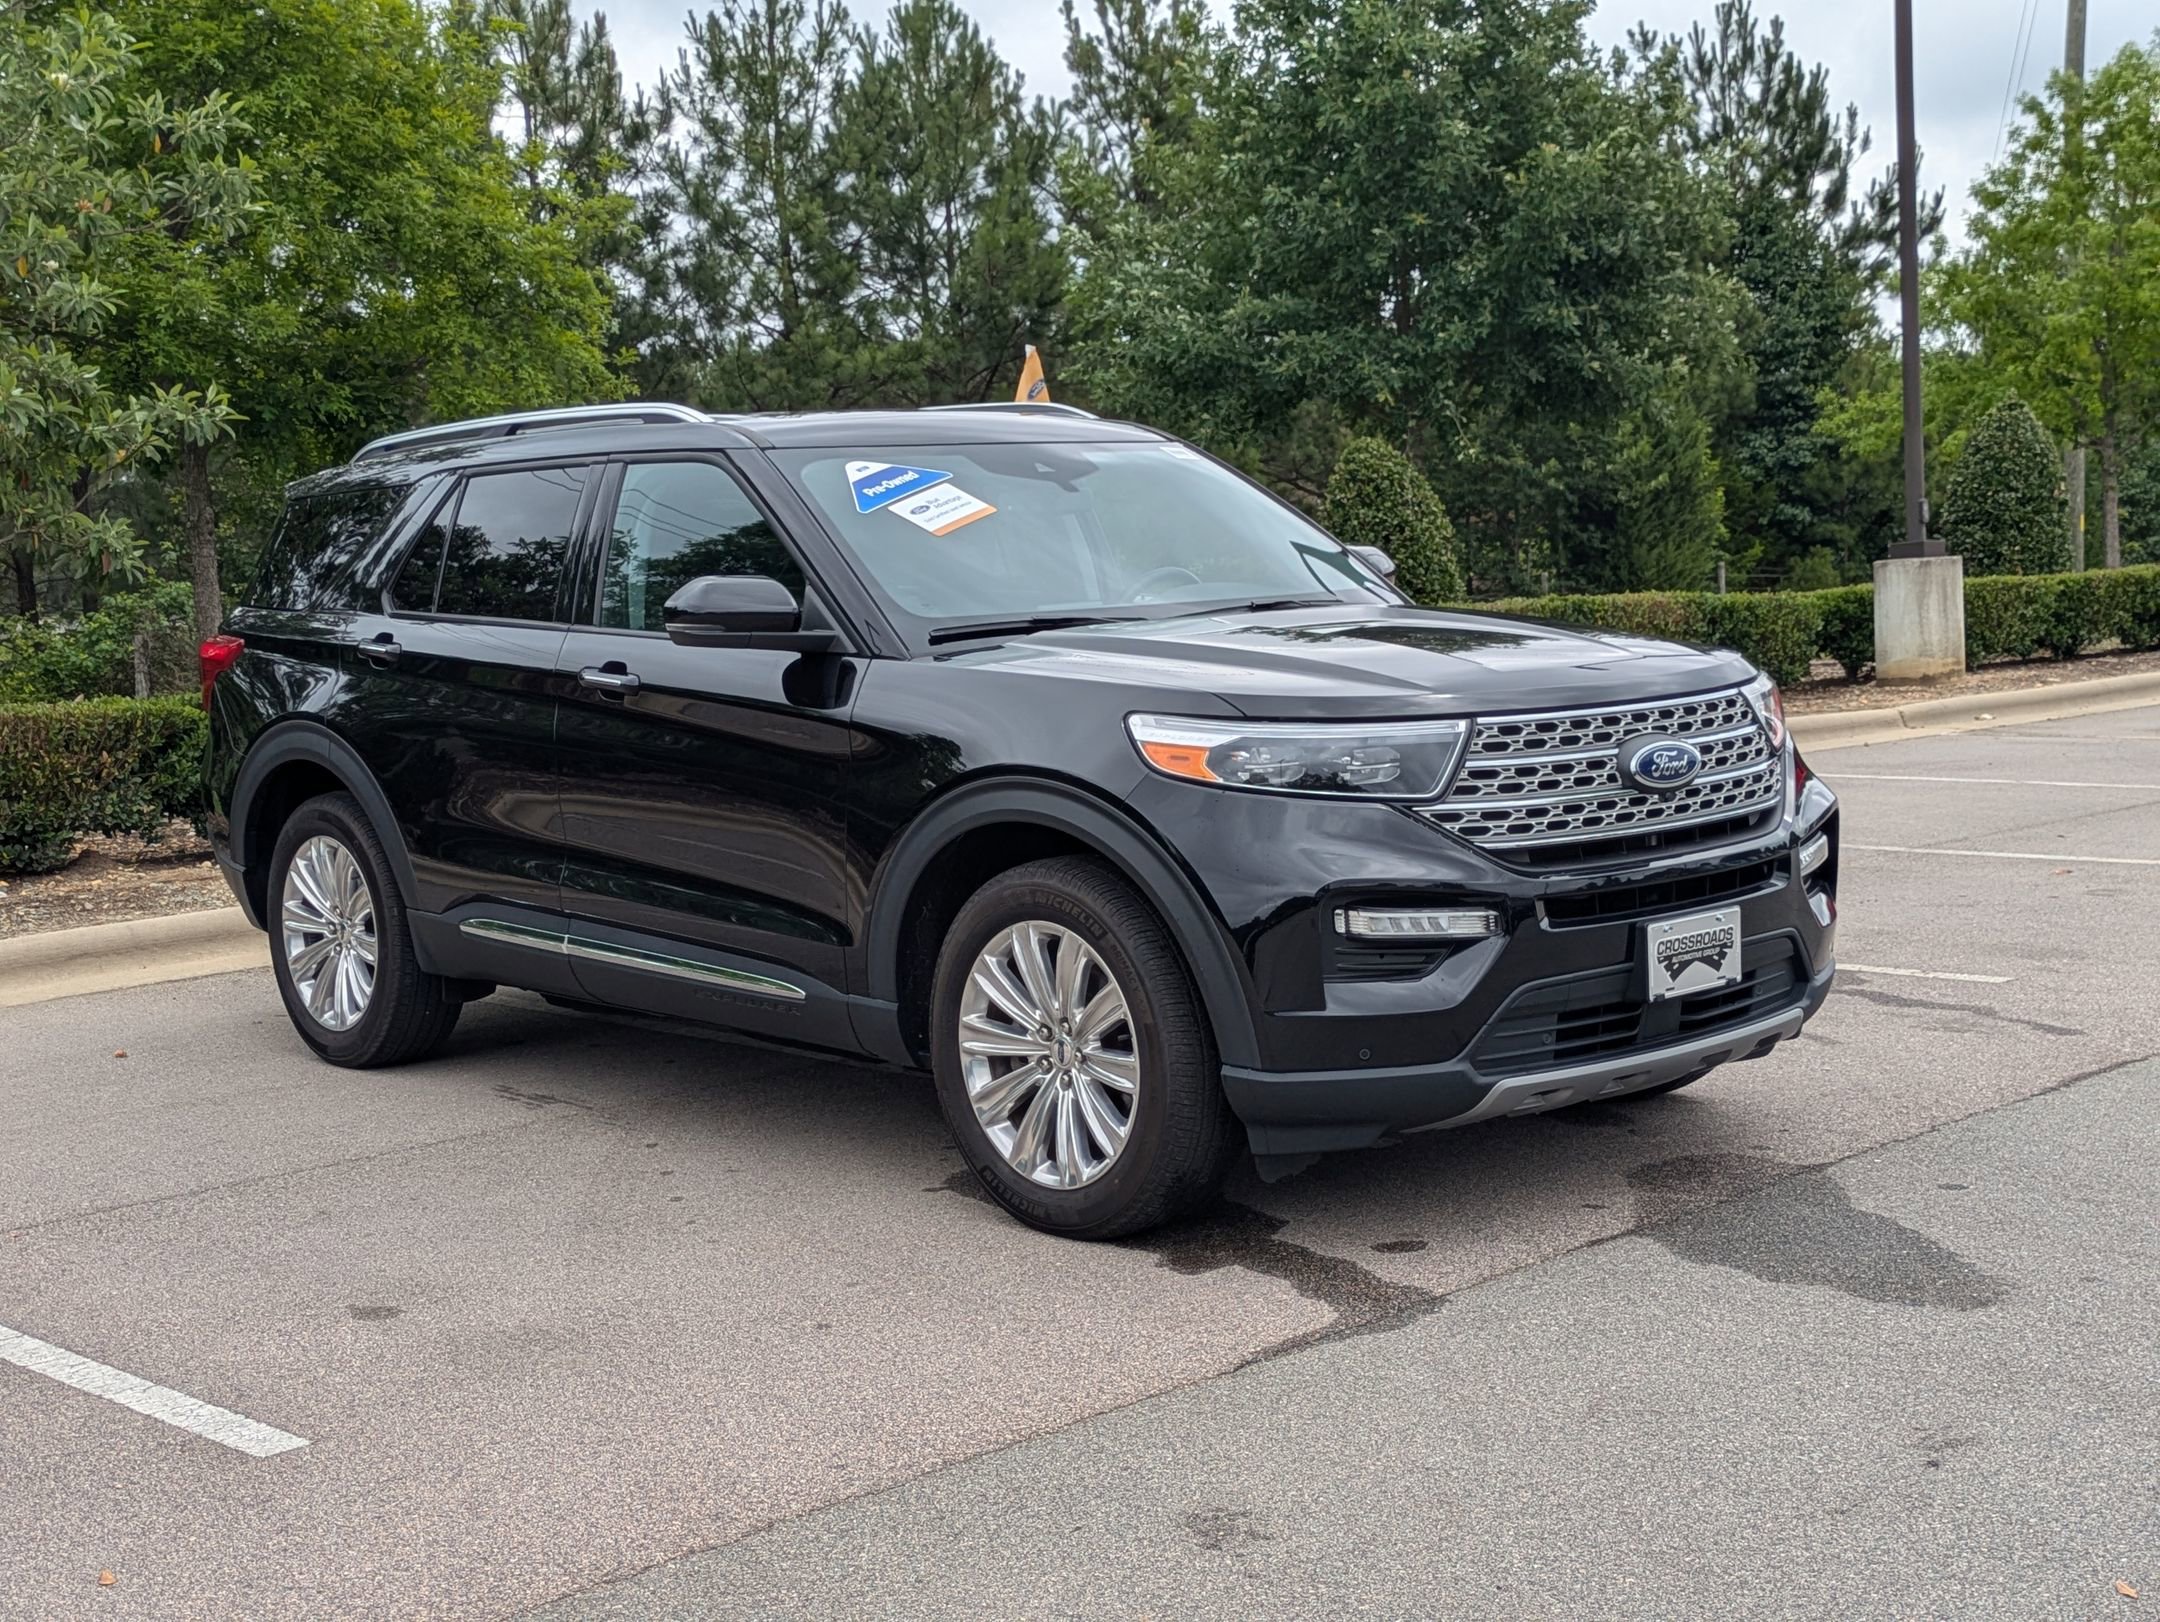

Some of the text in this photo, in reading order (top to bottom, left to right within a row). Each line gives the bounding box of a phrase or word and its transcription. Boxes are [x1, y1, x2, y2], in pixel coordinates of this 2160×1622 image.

[862, 471, 920, 497] Pre-Owned
[1651, 750, 1689, 777] Ford
[1034, 892, 1105, 938] MICHELIN
[1657, 926, 1734, 956] CROSSROADS
